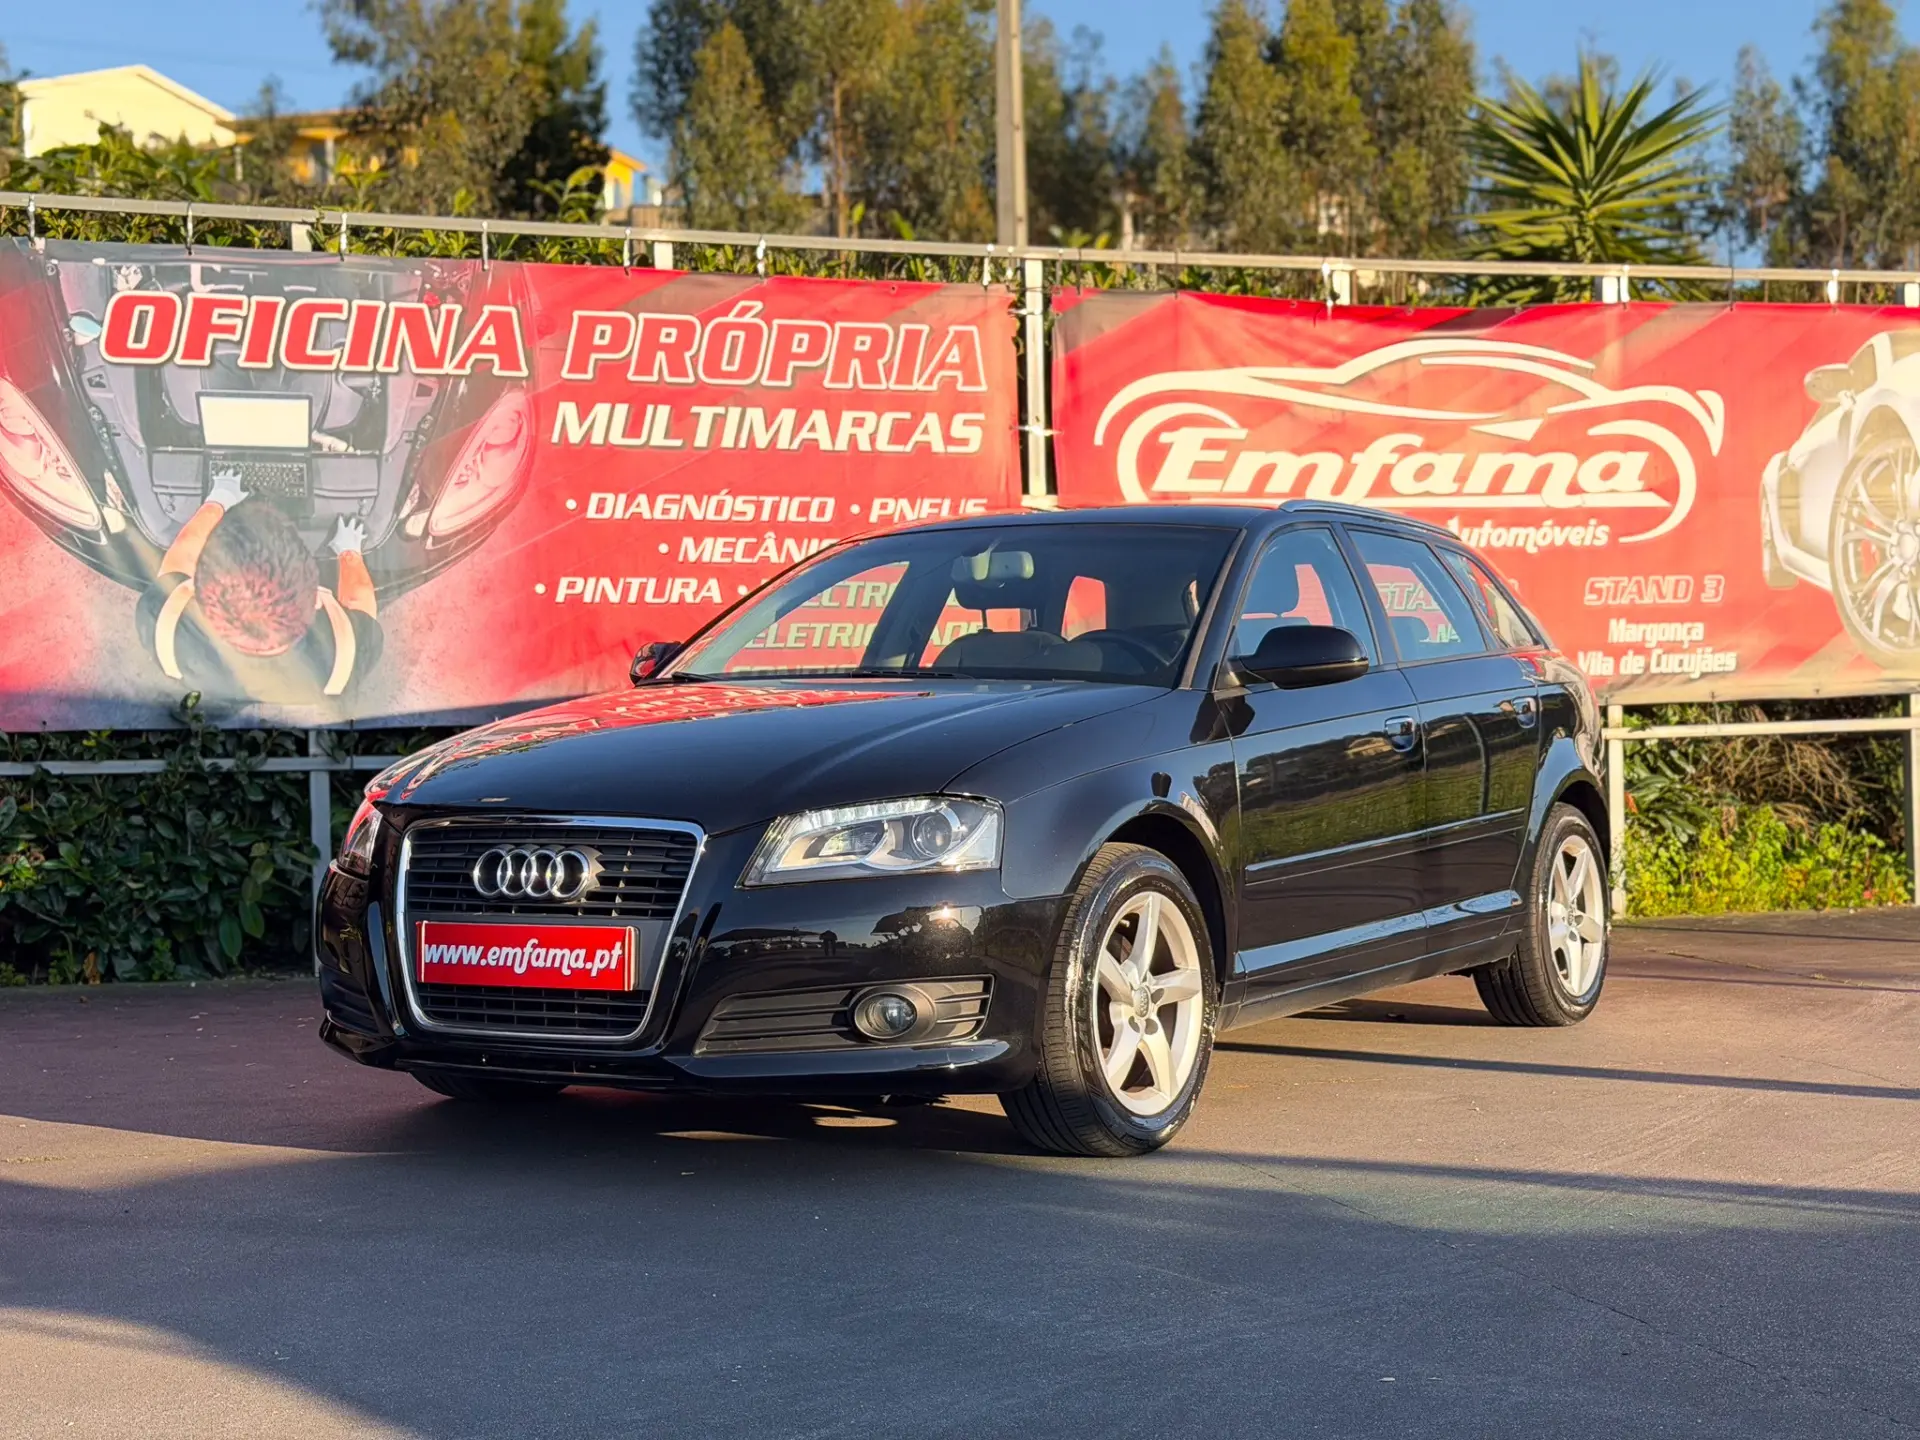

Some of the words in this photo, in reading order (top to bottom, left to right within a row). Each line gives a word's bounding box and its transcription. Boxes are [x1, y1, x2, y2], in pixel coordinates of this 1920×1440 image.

[100, 290, 529, 377] OFICINA
[561, 300, 988, 392] PRÓPRIA
[551, 401, 986, 454] MULTIMARCAS
[1150, 426, 1652, 508] Emfama
[586, 489, 835, 523] DIAGNÓSTICO
[678, 531, 840, 564] MECÂNI
[555, 576, 724, 605] PINTURA
[1584, 575, 1694, 605] STAND
[1700, 574, 1725, 603] 3
[1607, 618, 1705, 649] Margonça
[1577, 651, 1615, 676] Vila
[1619, 649, 1646, 676] de
[1650, 647, 1738, 680] Cucujães
[424, 938, 623, 977] www.emfama.pt
